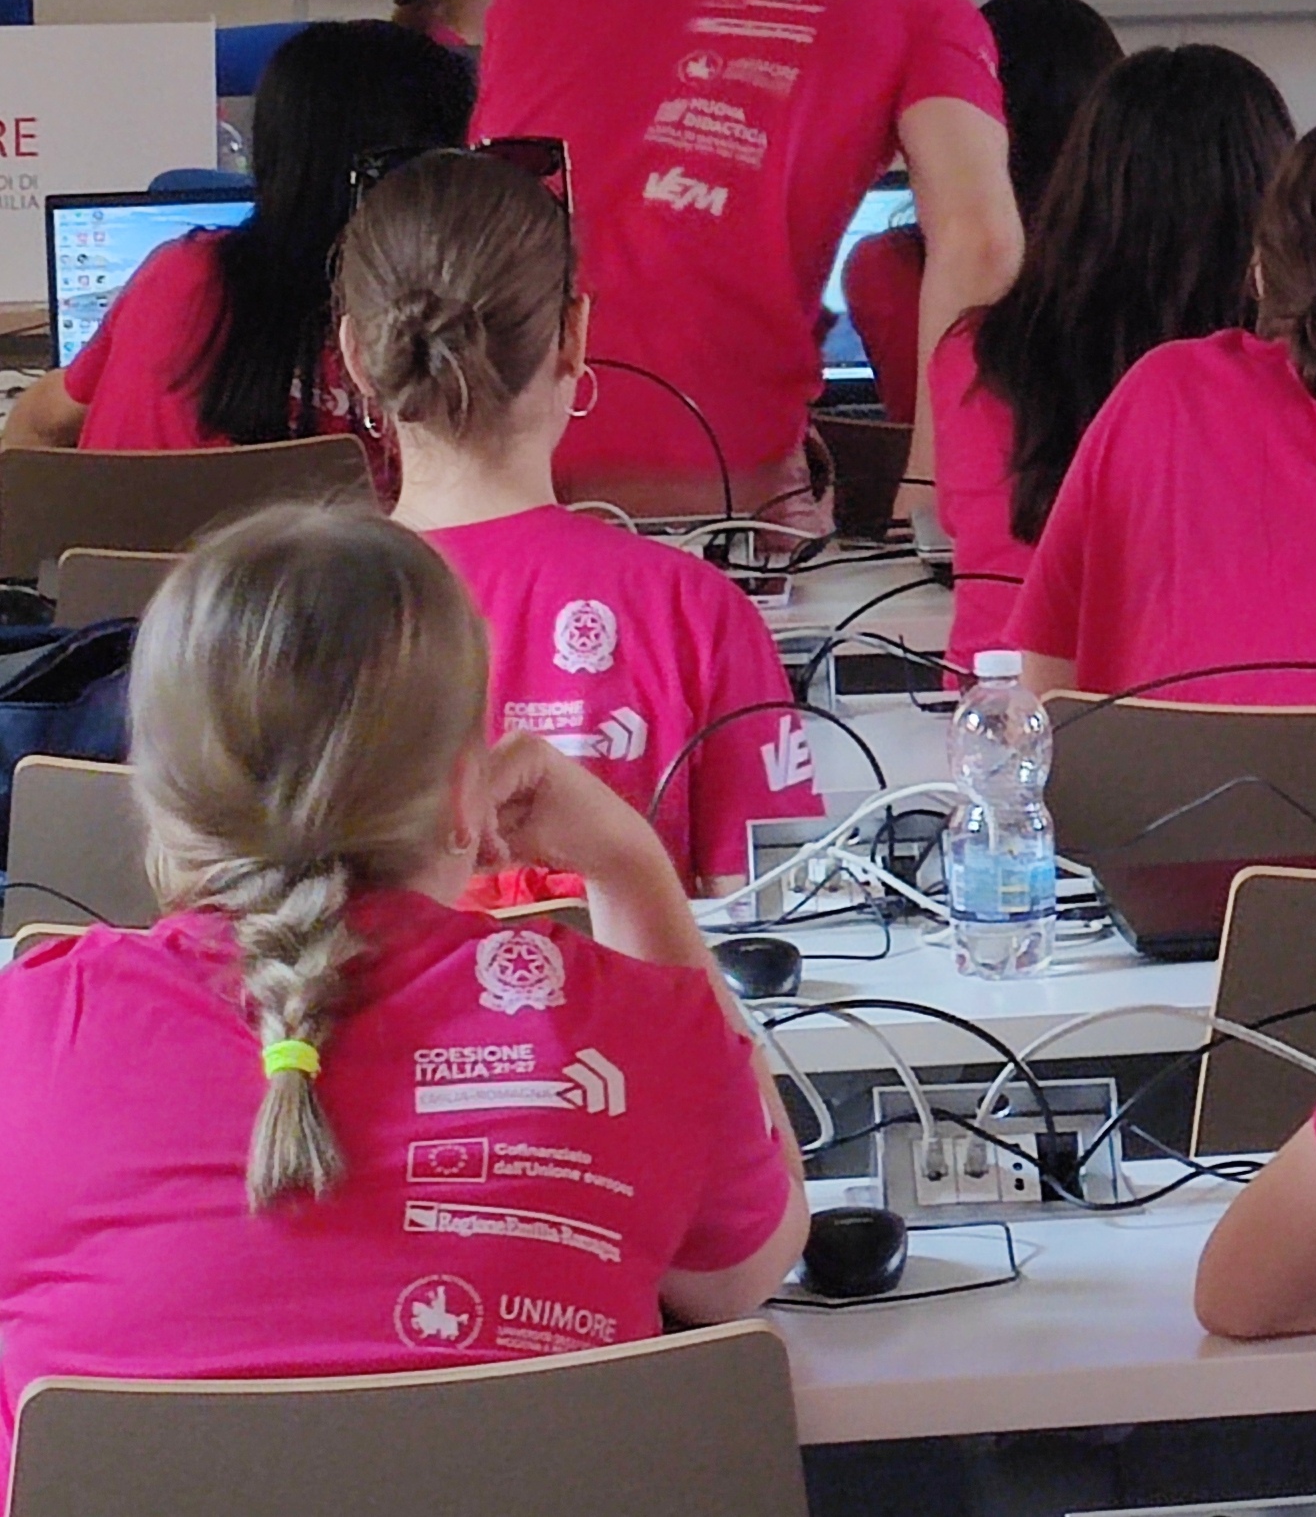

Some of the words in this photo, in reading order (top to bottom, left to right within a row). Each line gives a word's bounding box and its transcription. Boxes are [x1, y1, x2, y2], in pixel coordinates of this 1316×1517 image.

[689, 98, 746, 123] NUOVA
[0, 117, 39, 158] E
[642, 166, 728, 216] VEM
[0, 195, 40, 211] ILIA
[504, 699, 585, 717] COESIONE
[504, 716, 555, 733] ITALIA
[414, 1043, 535, 1063] COESIONE
[415, 1061, 490, 1082] ITALIA
[499, 1293, 618, 1344] UNIMORE
